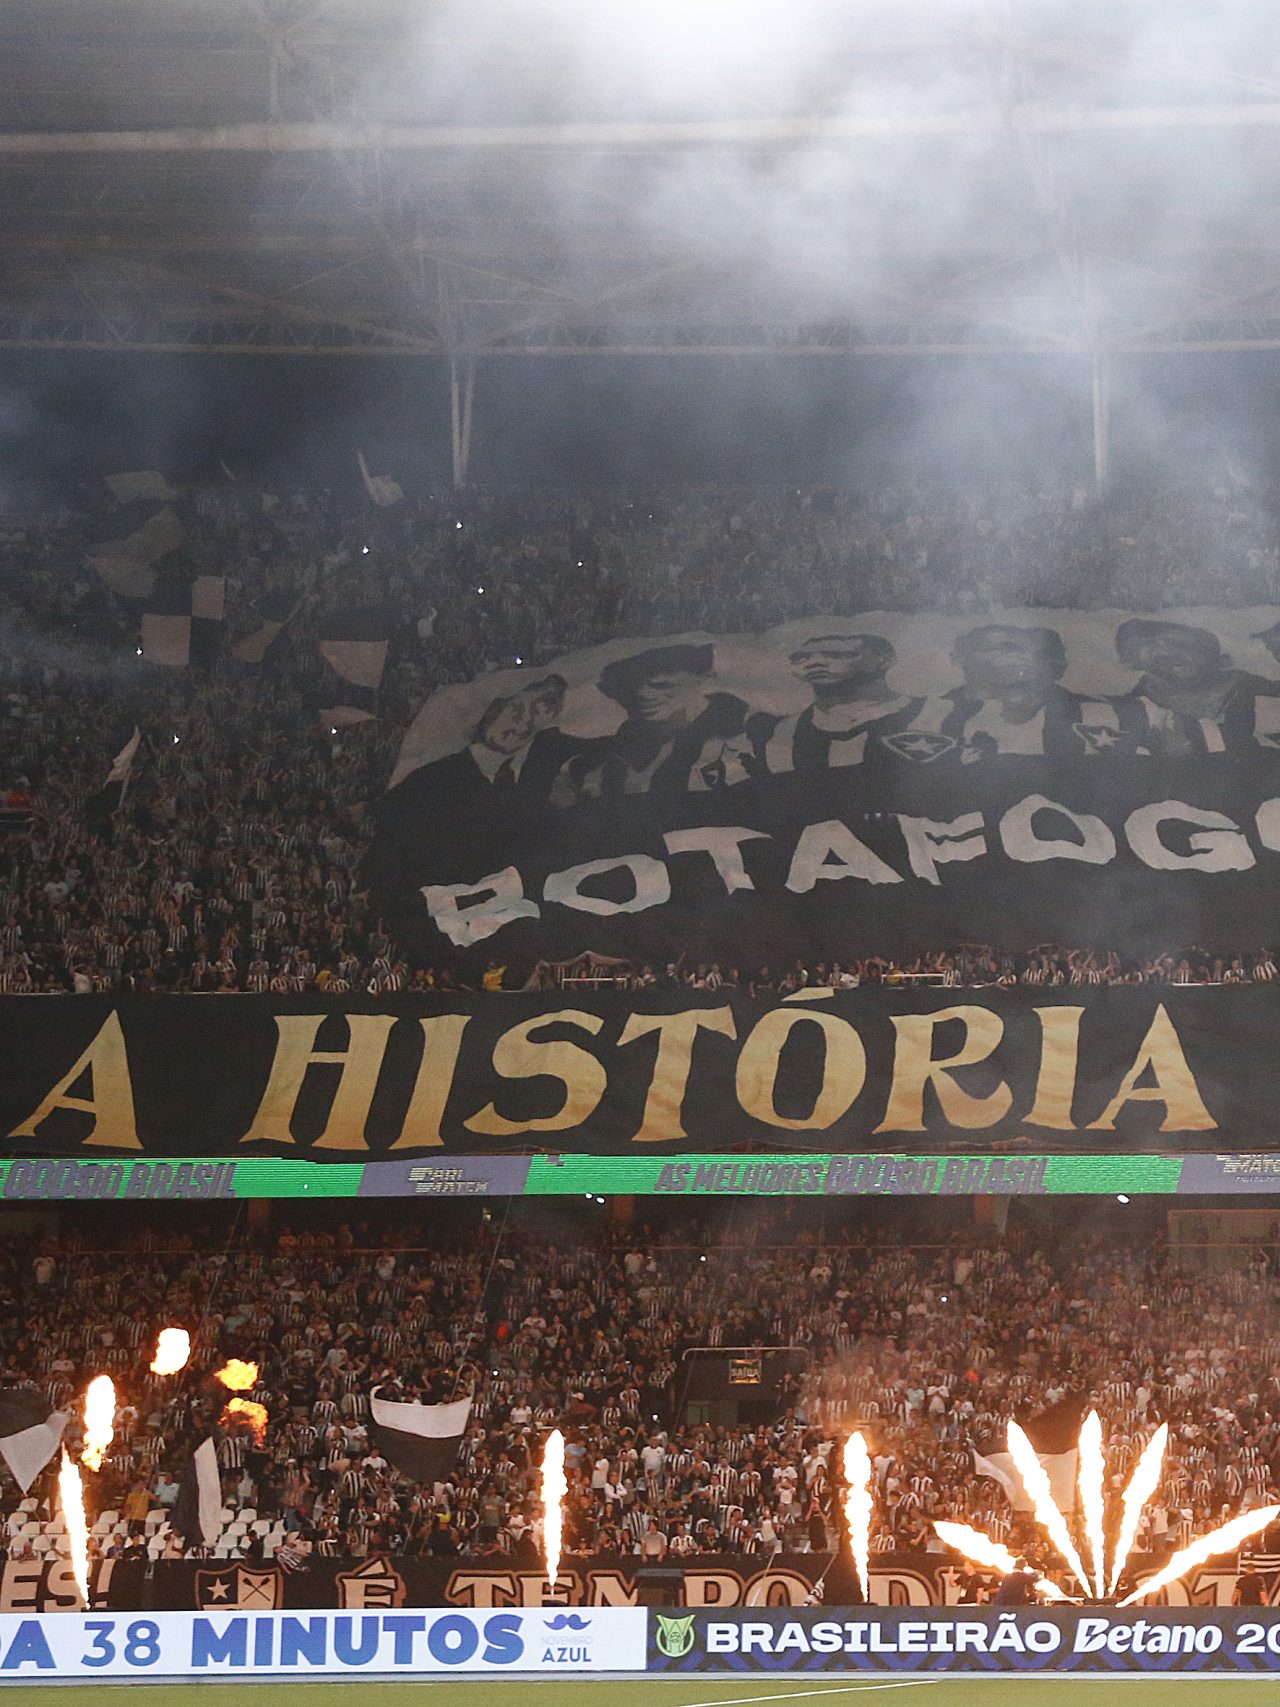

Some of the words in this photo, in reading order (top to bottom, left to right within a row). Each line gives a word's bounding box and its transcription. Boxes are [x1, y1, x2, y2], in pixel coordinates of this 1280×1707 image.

[5, 1008, 145, 1151] A
[240, 987, 1219, 1151] HISTÓRIA
[125, 1163, 238, 1198] BRASIL
[655, 1163, 692, 1192] AS
[692, 1163, 824, 1192] MELHORES
[937, 1157, 1049, 1194] BRASIL
[341, 1558, 396, 1608] É
[0, 1620, 57, 1669] A
[81, 1619, 161, 1667] 38
[191, 1613, 525, 1667] MINUTOS
[707, 1614, 1061, 1653] BRASILEIRÃO
[1073, 1618, 1223, 1653] Betano
[541, 1647, 592, 1662] AZUL
